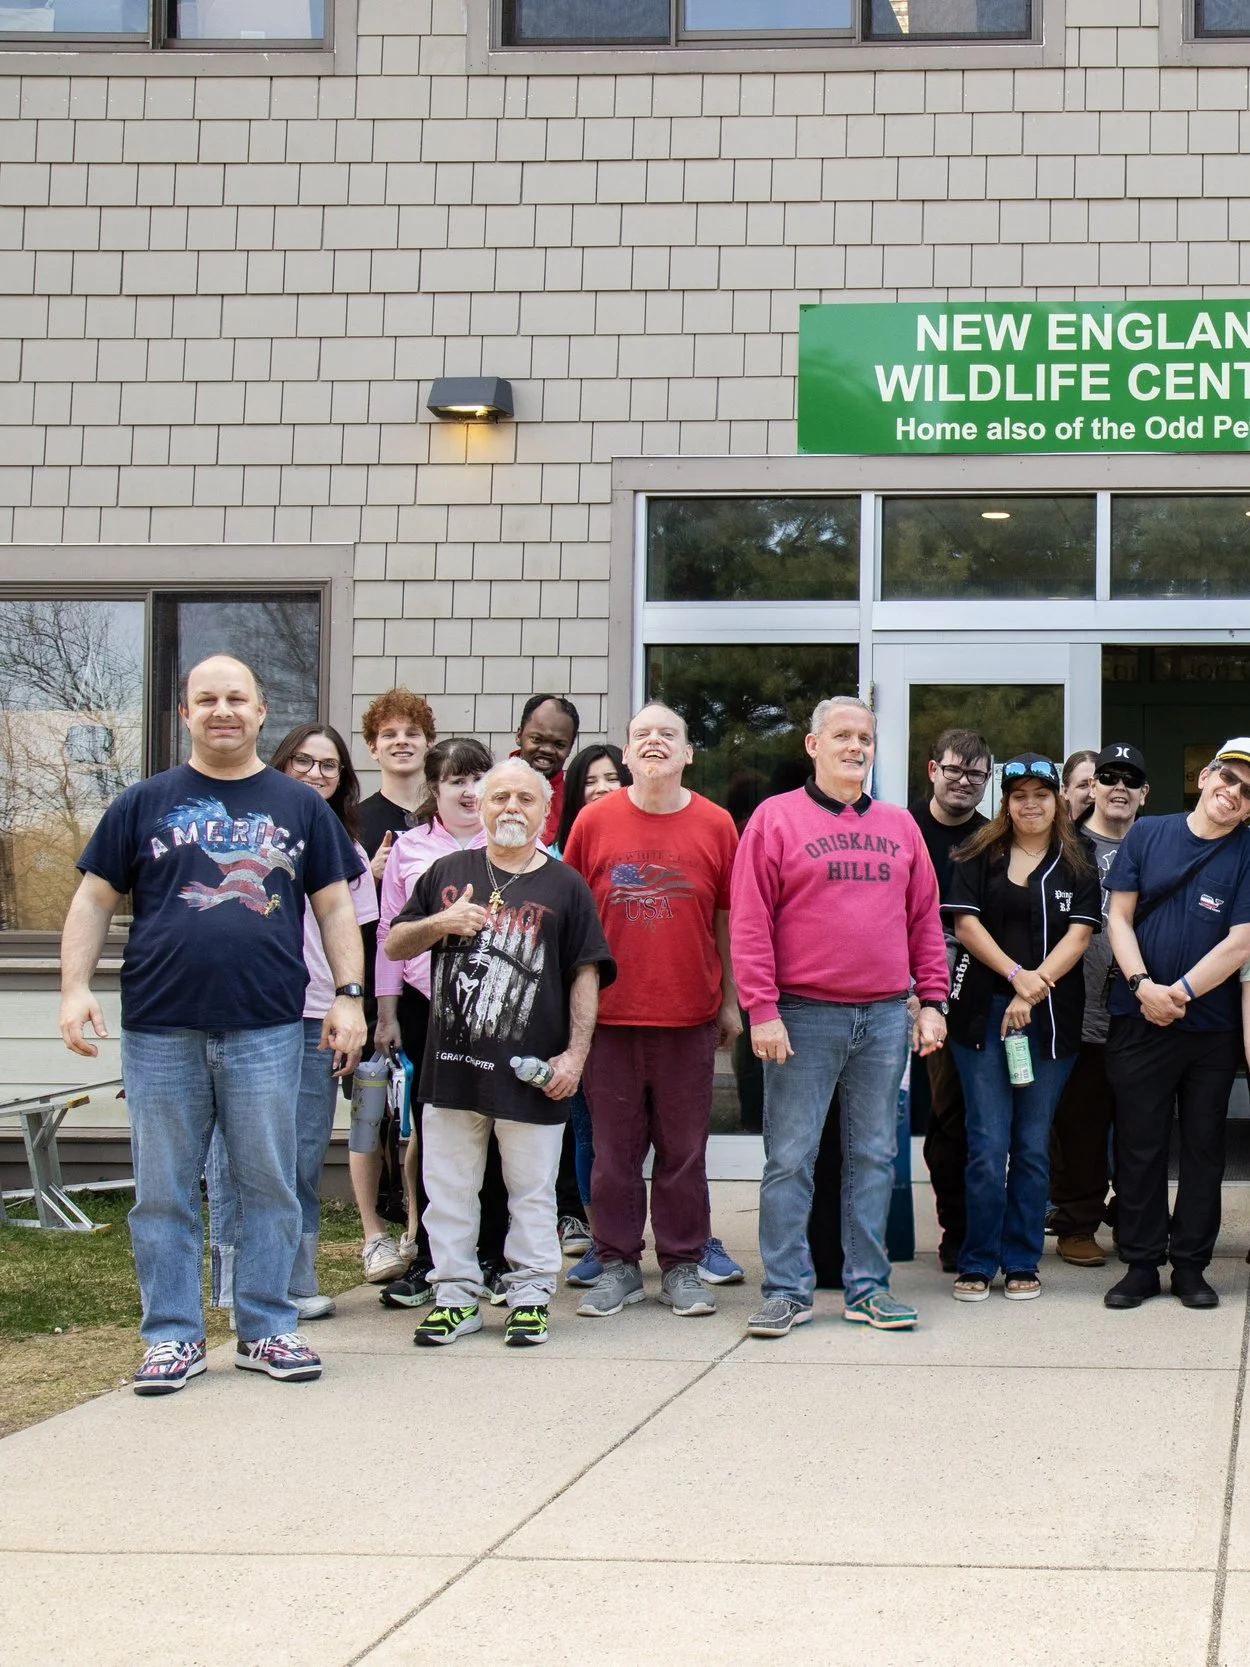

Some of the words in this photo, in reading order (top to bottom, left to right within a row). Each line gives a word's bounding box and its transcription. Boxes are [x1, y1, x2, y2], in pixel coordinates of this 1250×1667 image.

[917, 314, 1032, 351] NEW
[874, 363, 1111, 402] WILDLIFE
[896, 417, 978, 440] Home
[986, 417, 1046, 440] also
[1055, 416, 1084, 440] of
[1091, 417, 1136, 440] the
[1145, 416, 1204, 439] Odd
[150, 820, 306, 862] AMERICA
[805, 832, 900, 859] ORISKANY
[827, 861, 891, 881] HILLS
[625, 896, 673, 921] USA
[440, 1052, 464, 1062] GRAY
